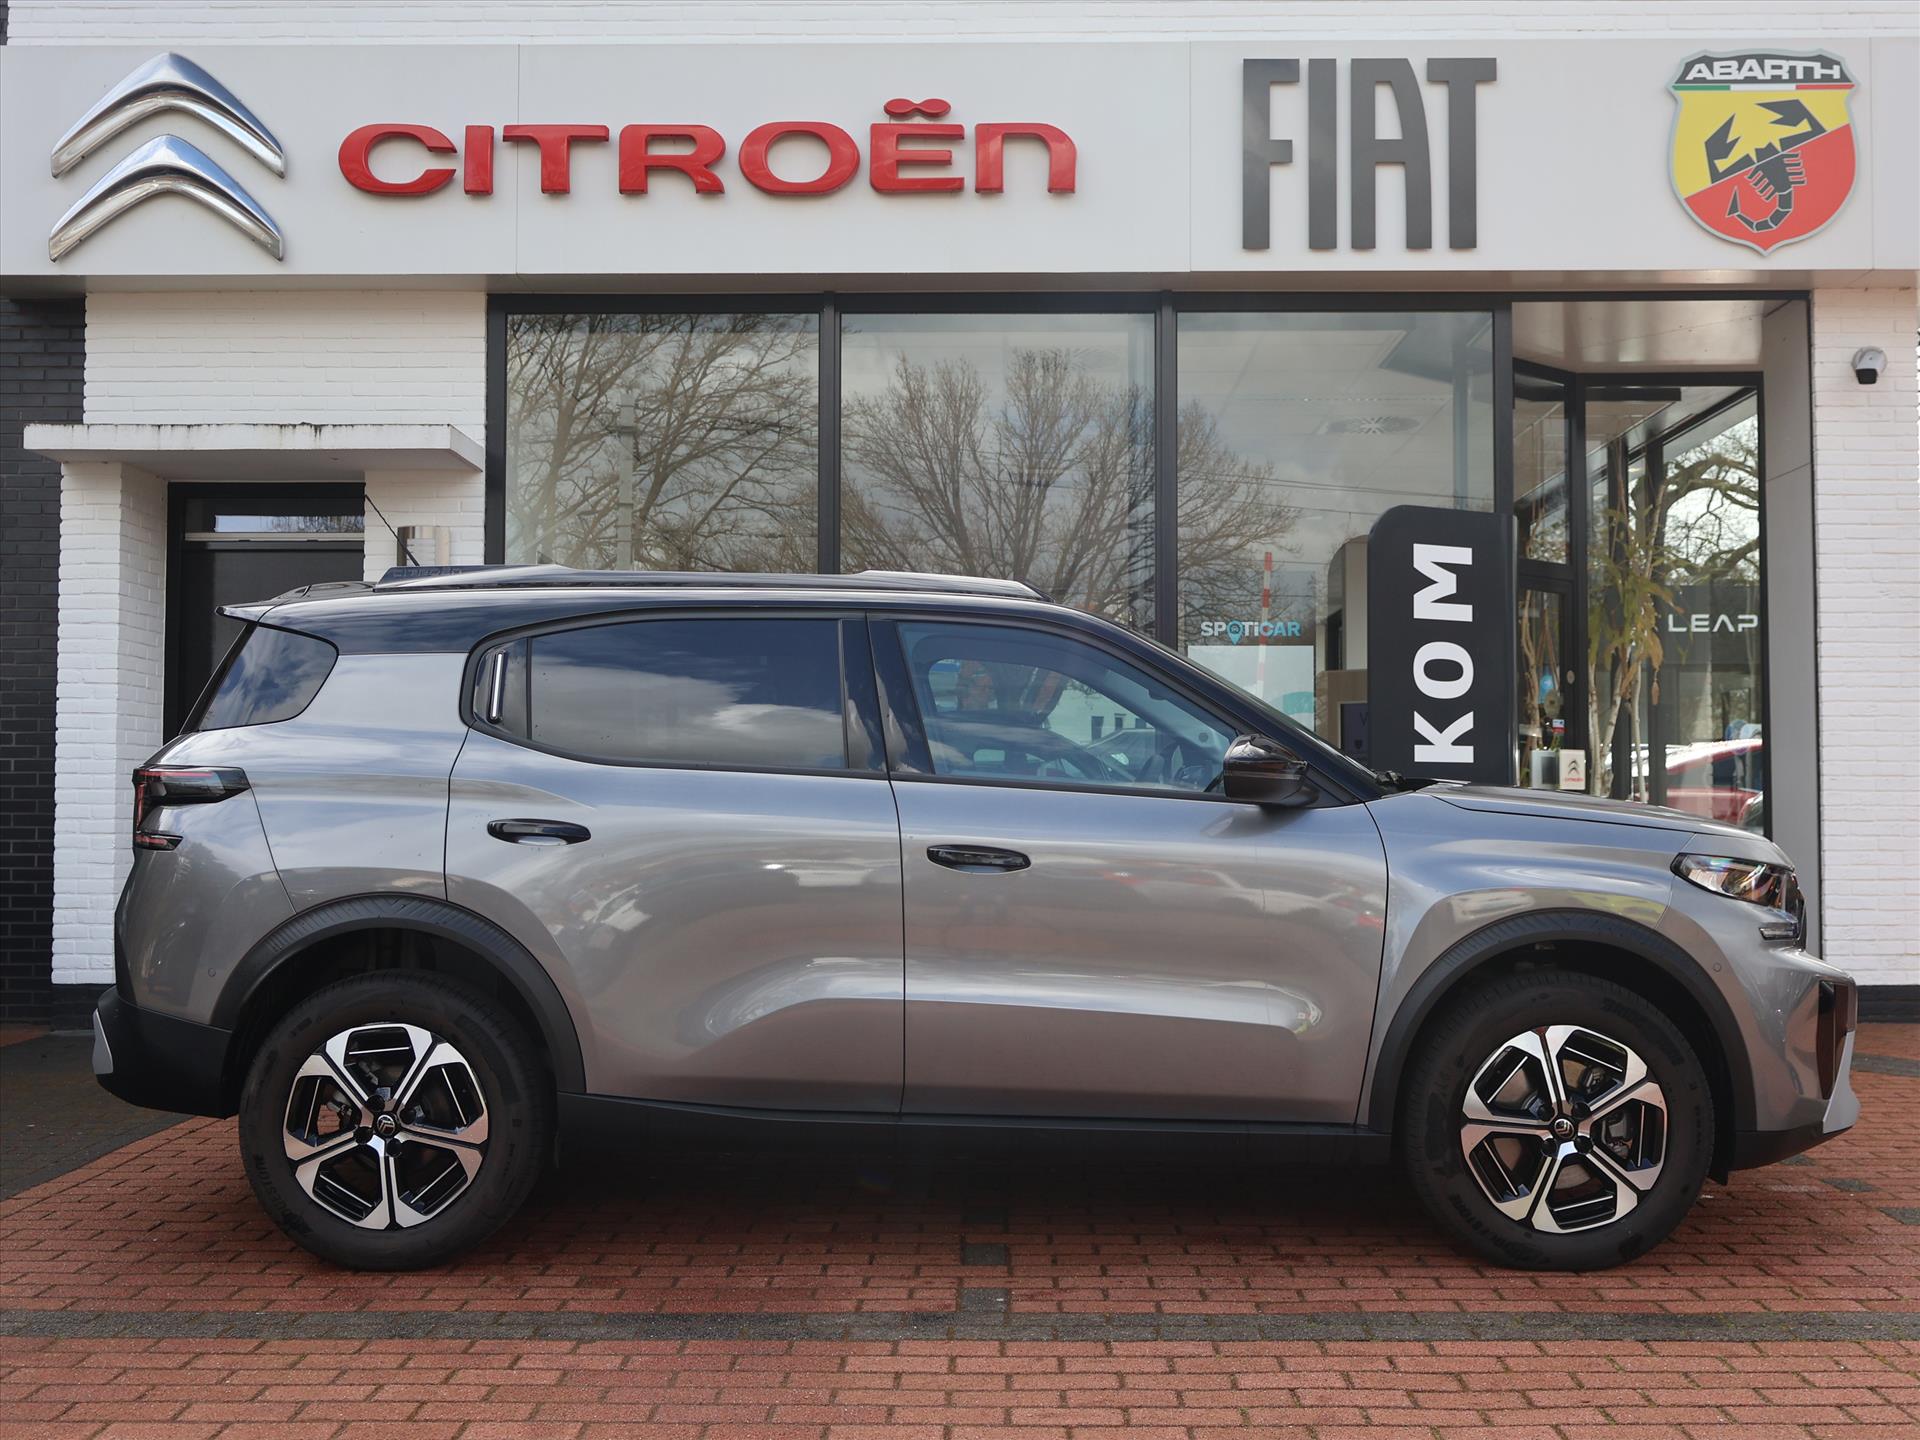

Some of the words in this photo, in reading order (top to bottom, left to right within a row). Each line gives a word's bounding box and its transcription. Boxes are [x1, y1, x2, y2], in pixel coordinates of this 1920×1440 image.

[1684, 58, 1841, 81] ABARTH
[338, 98, 1077, 197] CITROËN
[1242, 58, 1497, 250] FIAT
[1413, 543, 1475, 764] KOM
[1667, 613, 1759, 633] LEAP
